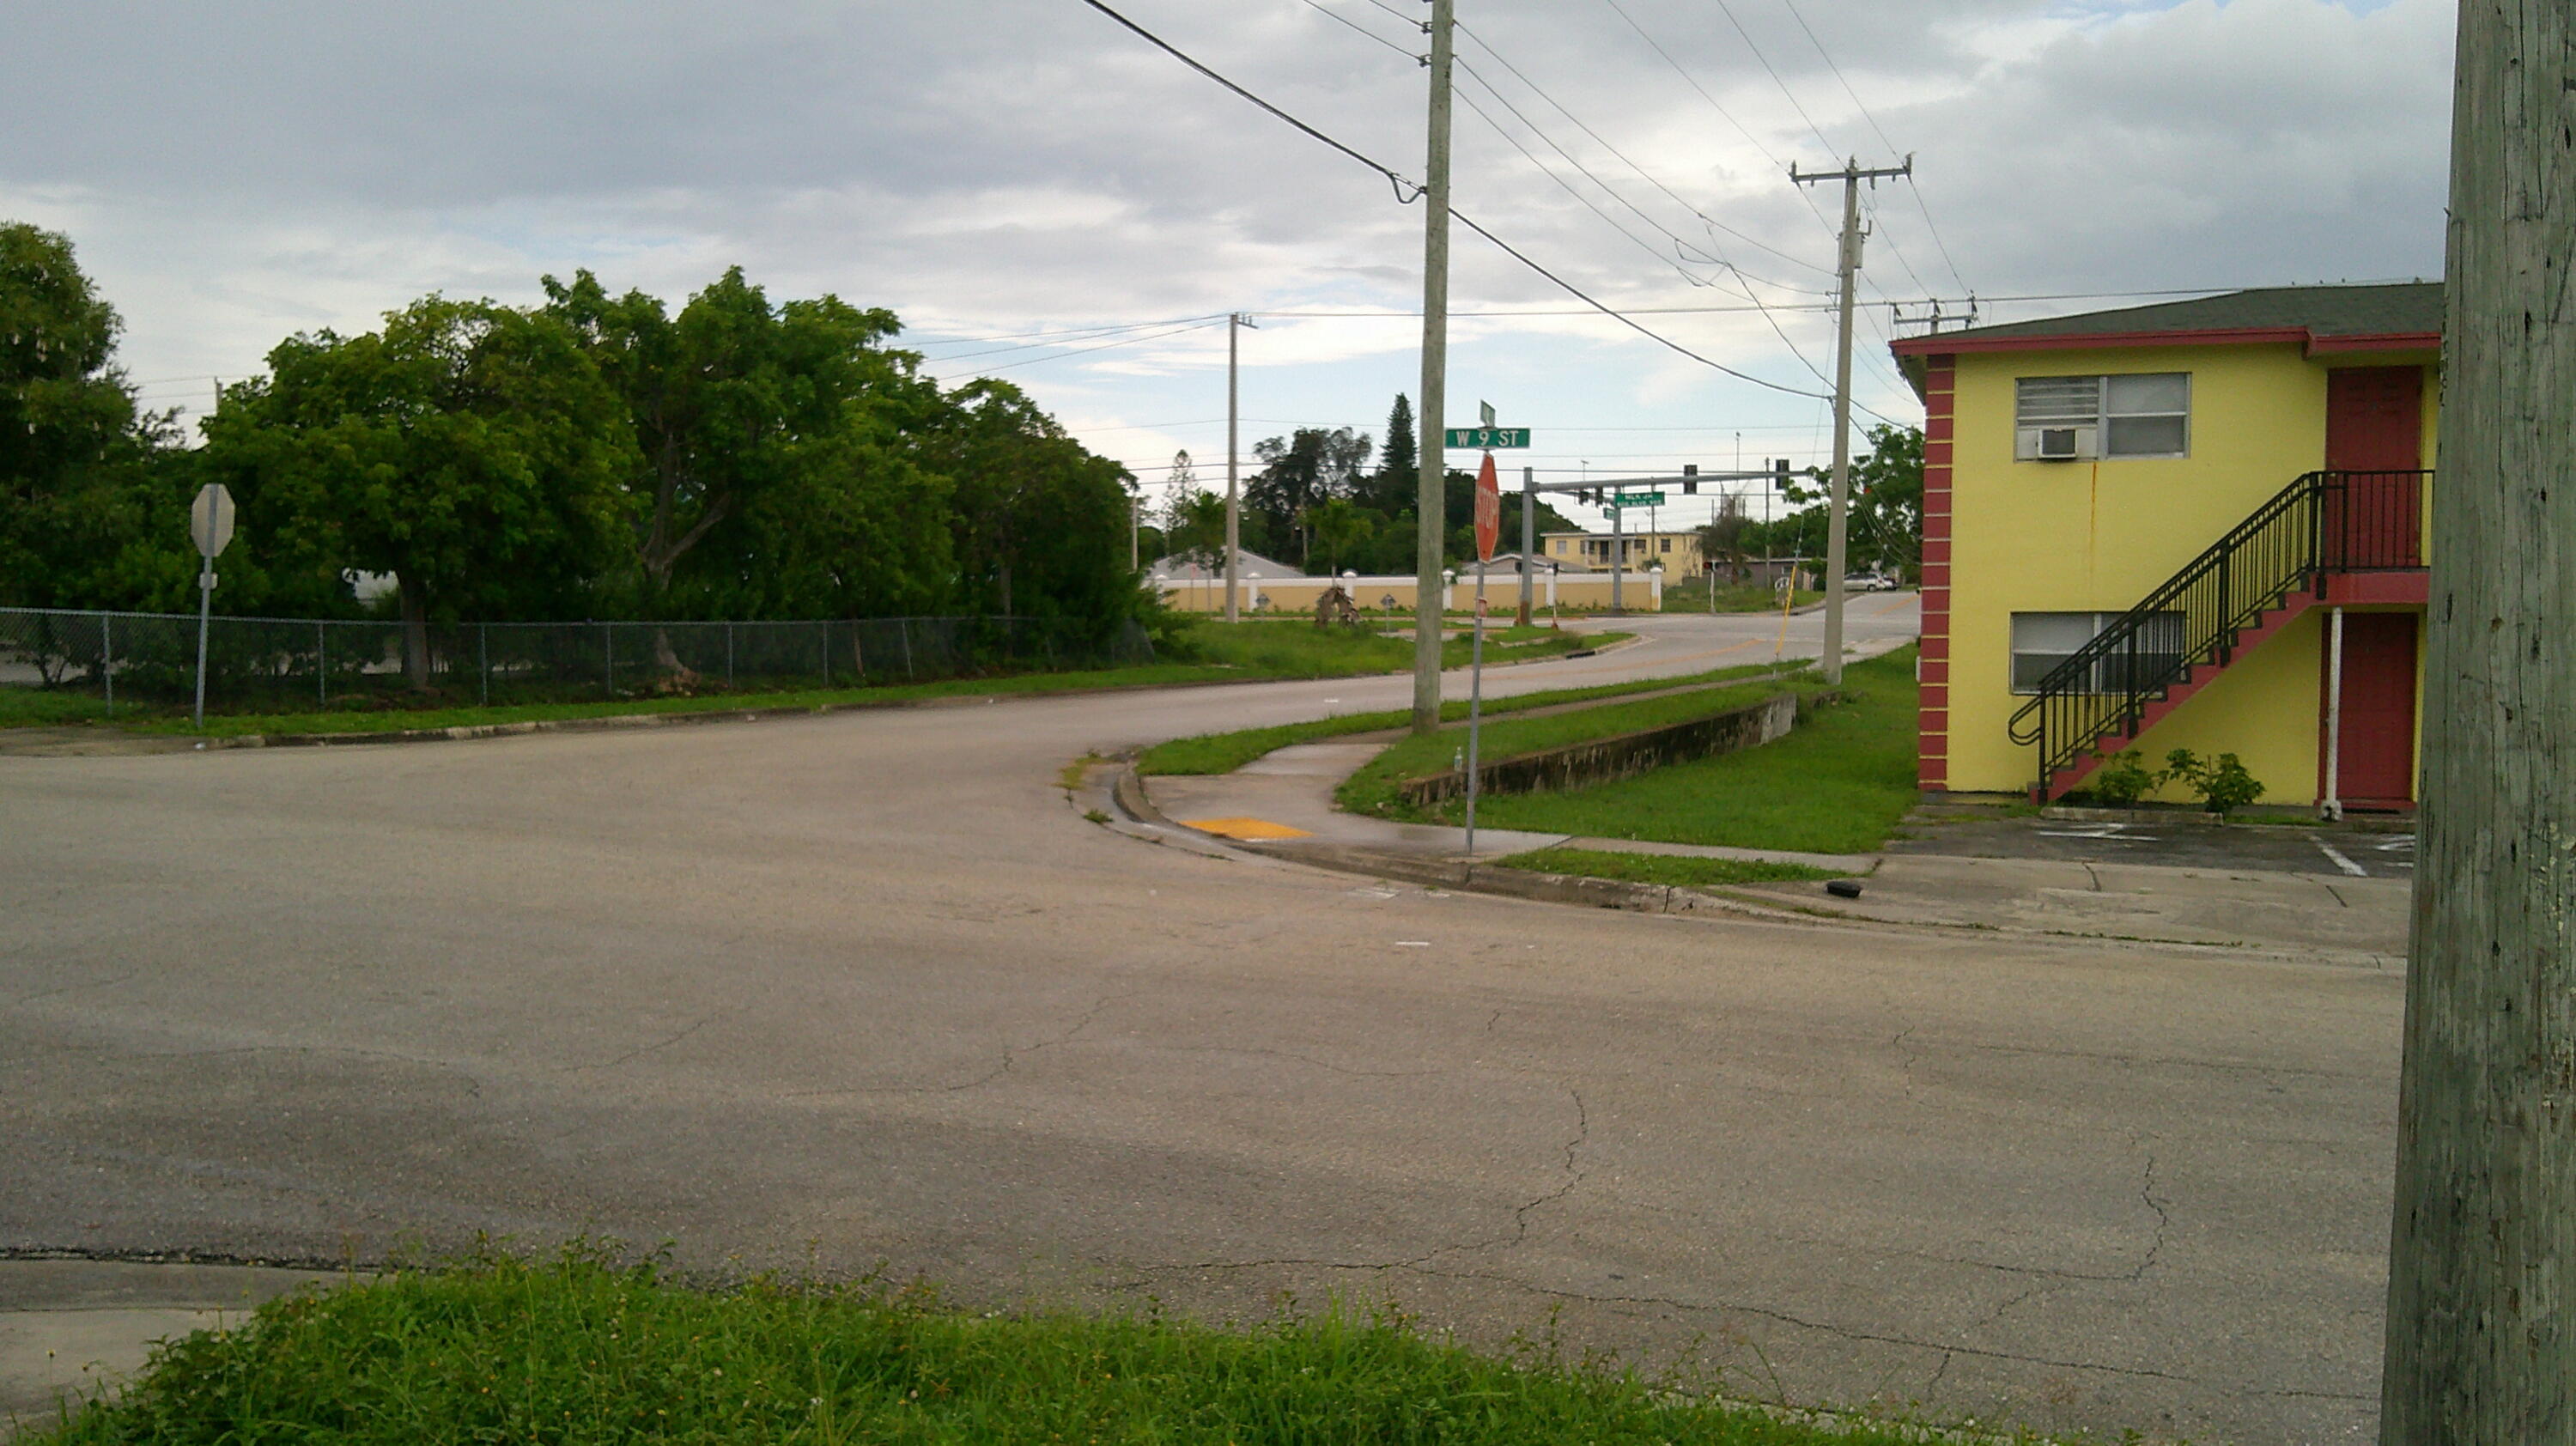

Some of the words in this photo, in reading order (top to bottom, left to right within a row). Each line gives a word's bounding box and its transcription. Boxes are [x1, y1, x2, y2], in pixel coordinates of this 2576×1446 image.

[1456, 430, 1470, 447] W
[1479, 431, 1490, 447] 9
[1498, 430, 1519, 447] ST
[1476, 486, 1499, 530] STOP
